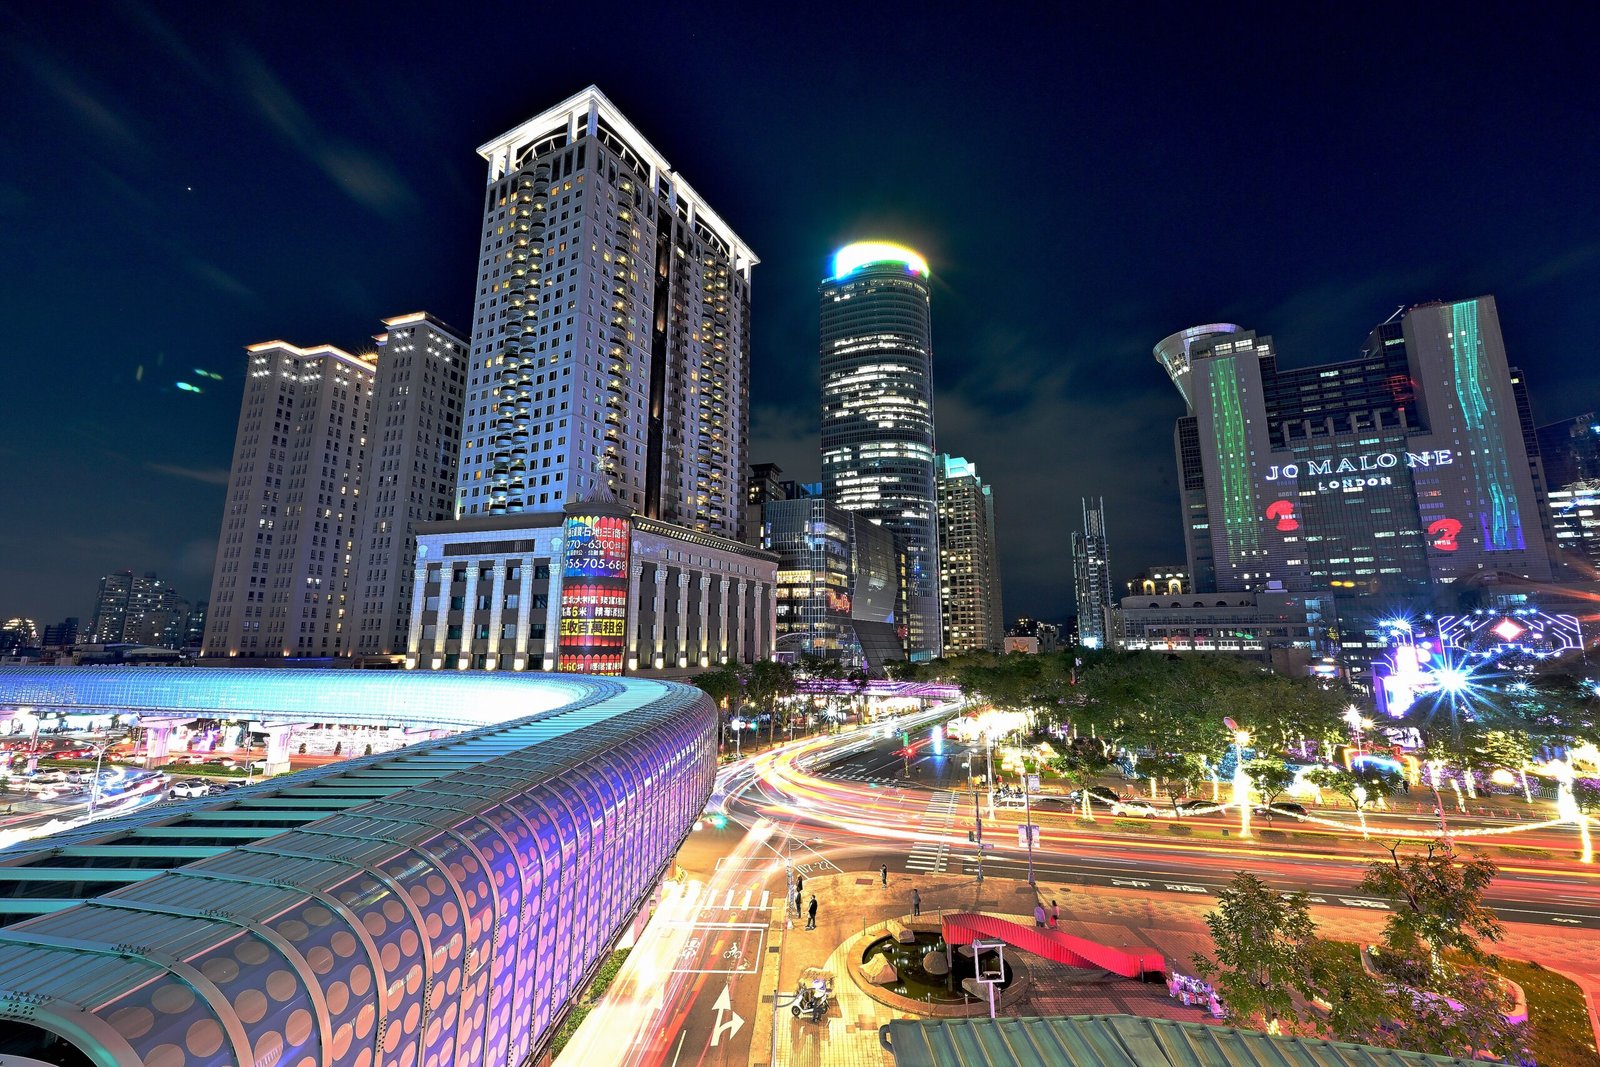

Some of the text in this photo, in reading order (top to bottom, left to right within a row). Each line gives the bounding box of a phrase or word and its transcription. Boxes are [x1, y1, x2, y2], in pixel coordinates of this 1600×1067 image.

[1265, 449, 1454, 481] JO MALONE
[1318, 476, 1393, 491] LONDON
